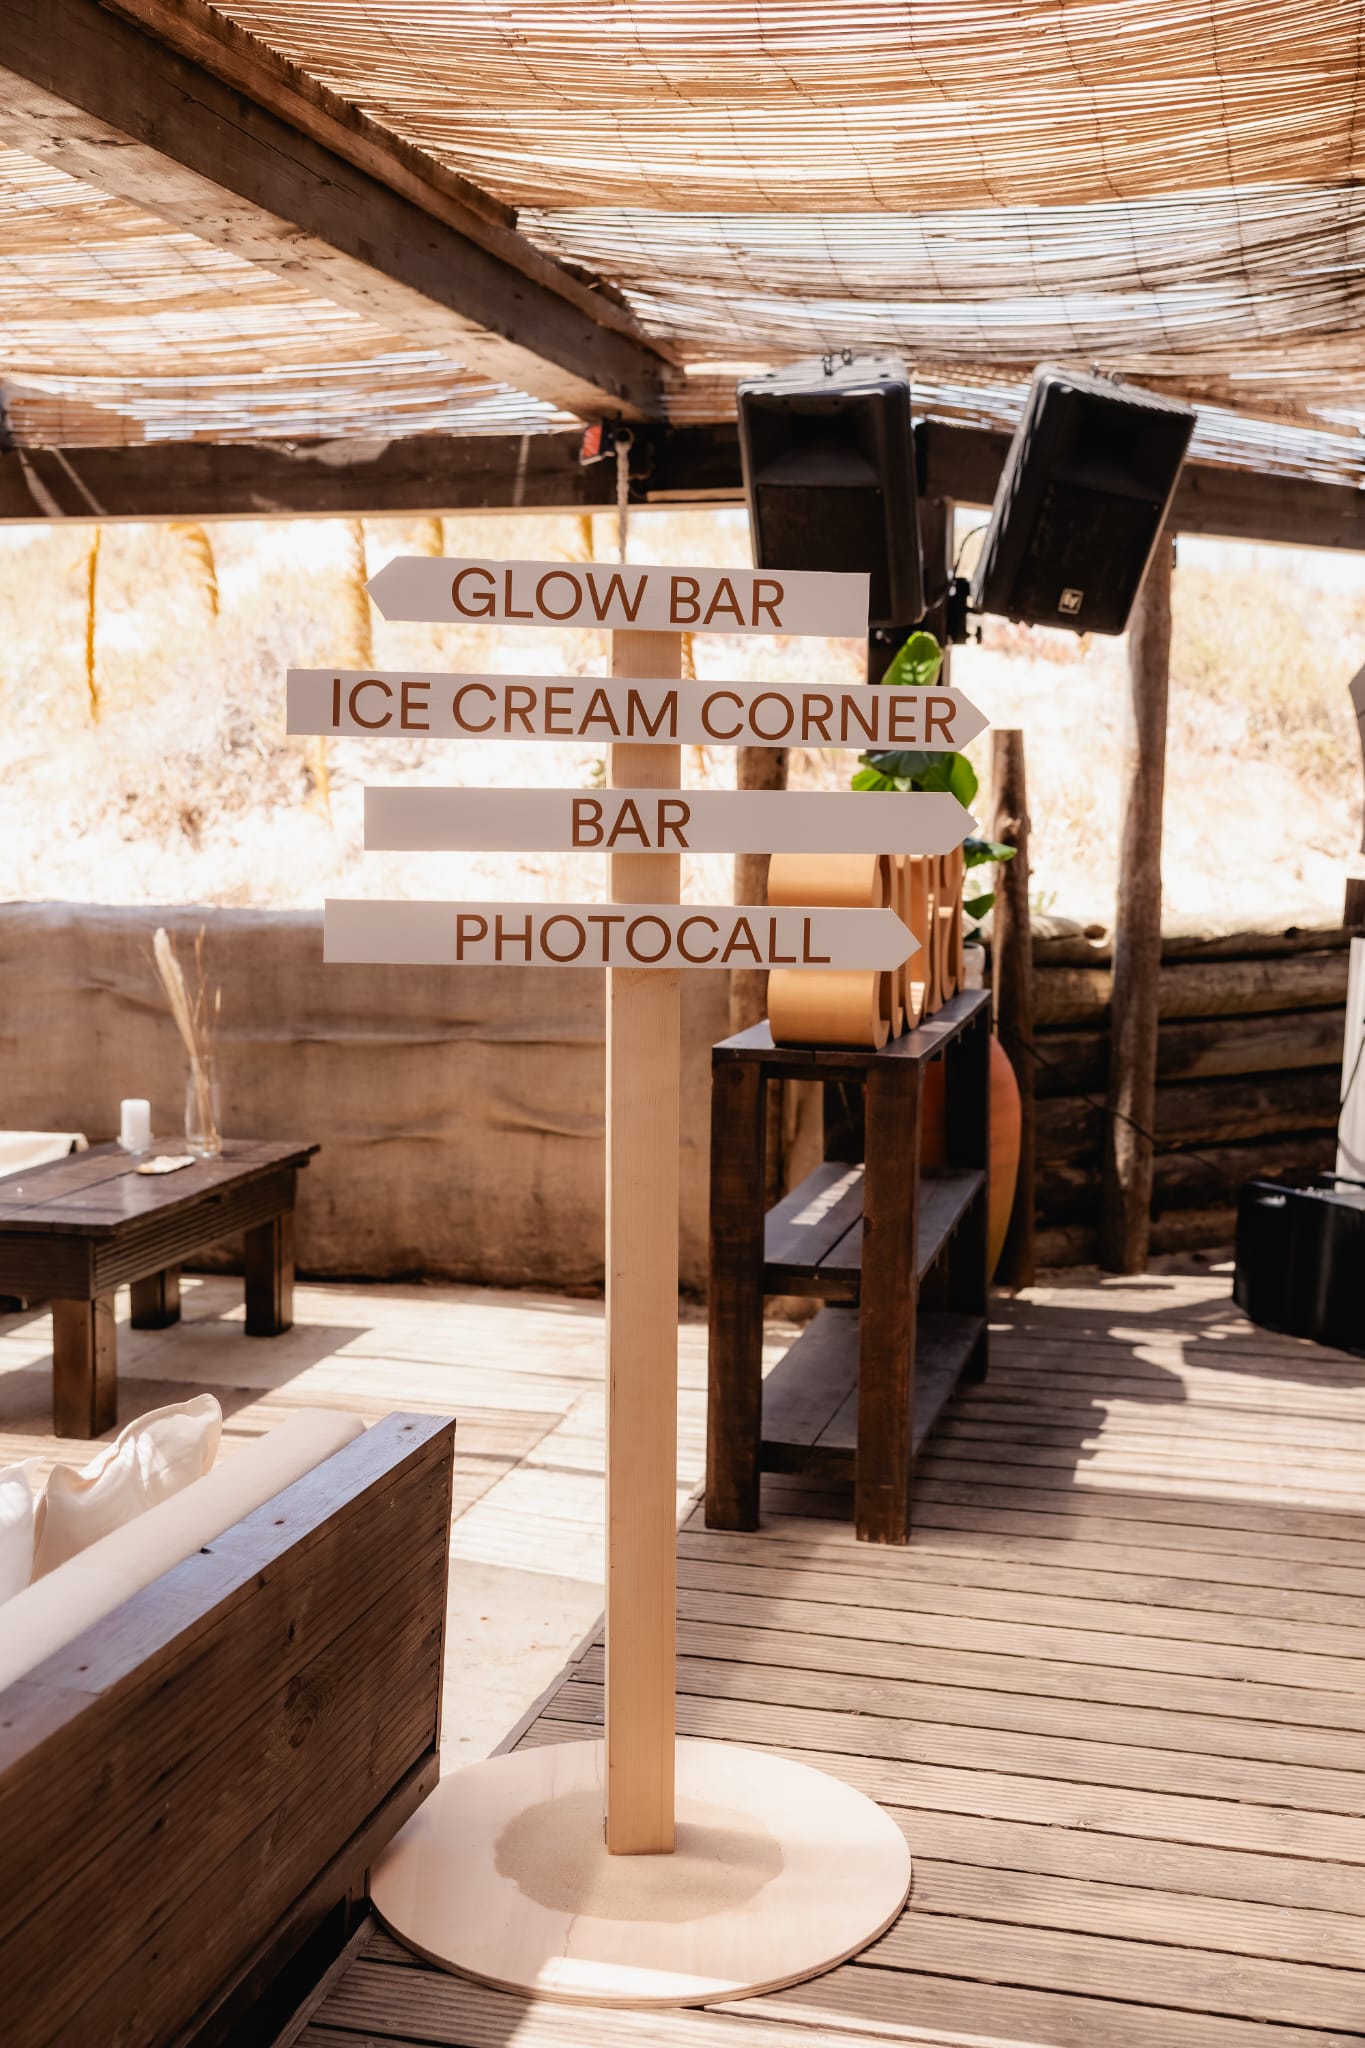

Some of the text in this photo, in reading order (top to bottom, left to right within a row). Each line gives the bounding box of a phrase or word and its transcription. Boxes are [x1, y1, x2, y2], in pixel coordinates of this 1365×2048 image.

[452, 567, 784, 627] GLOW BAR
[333, 679, 956, 743] ICE CREAM CORNER
[572, 799, 690, 847] BAR
[455, 914, 830, 963] PHOTOCALL
